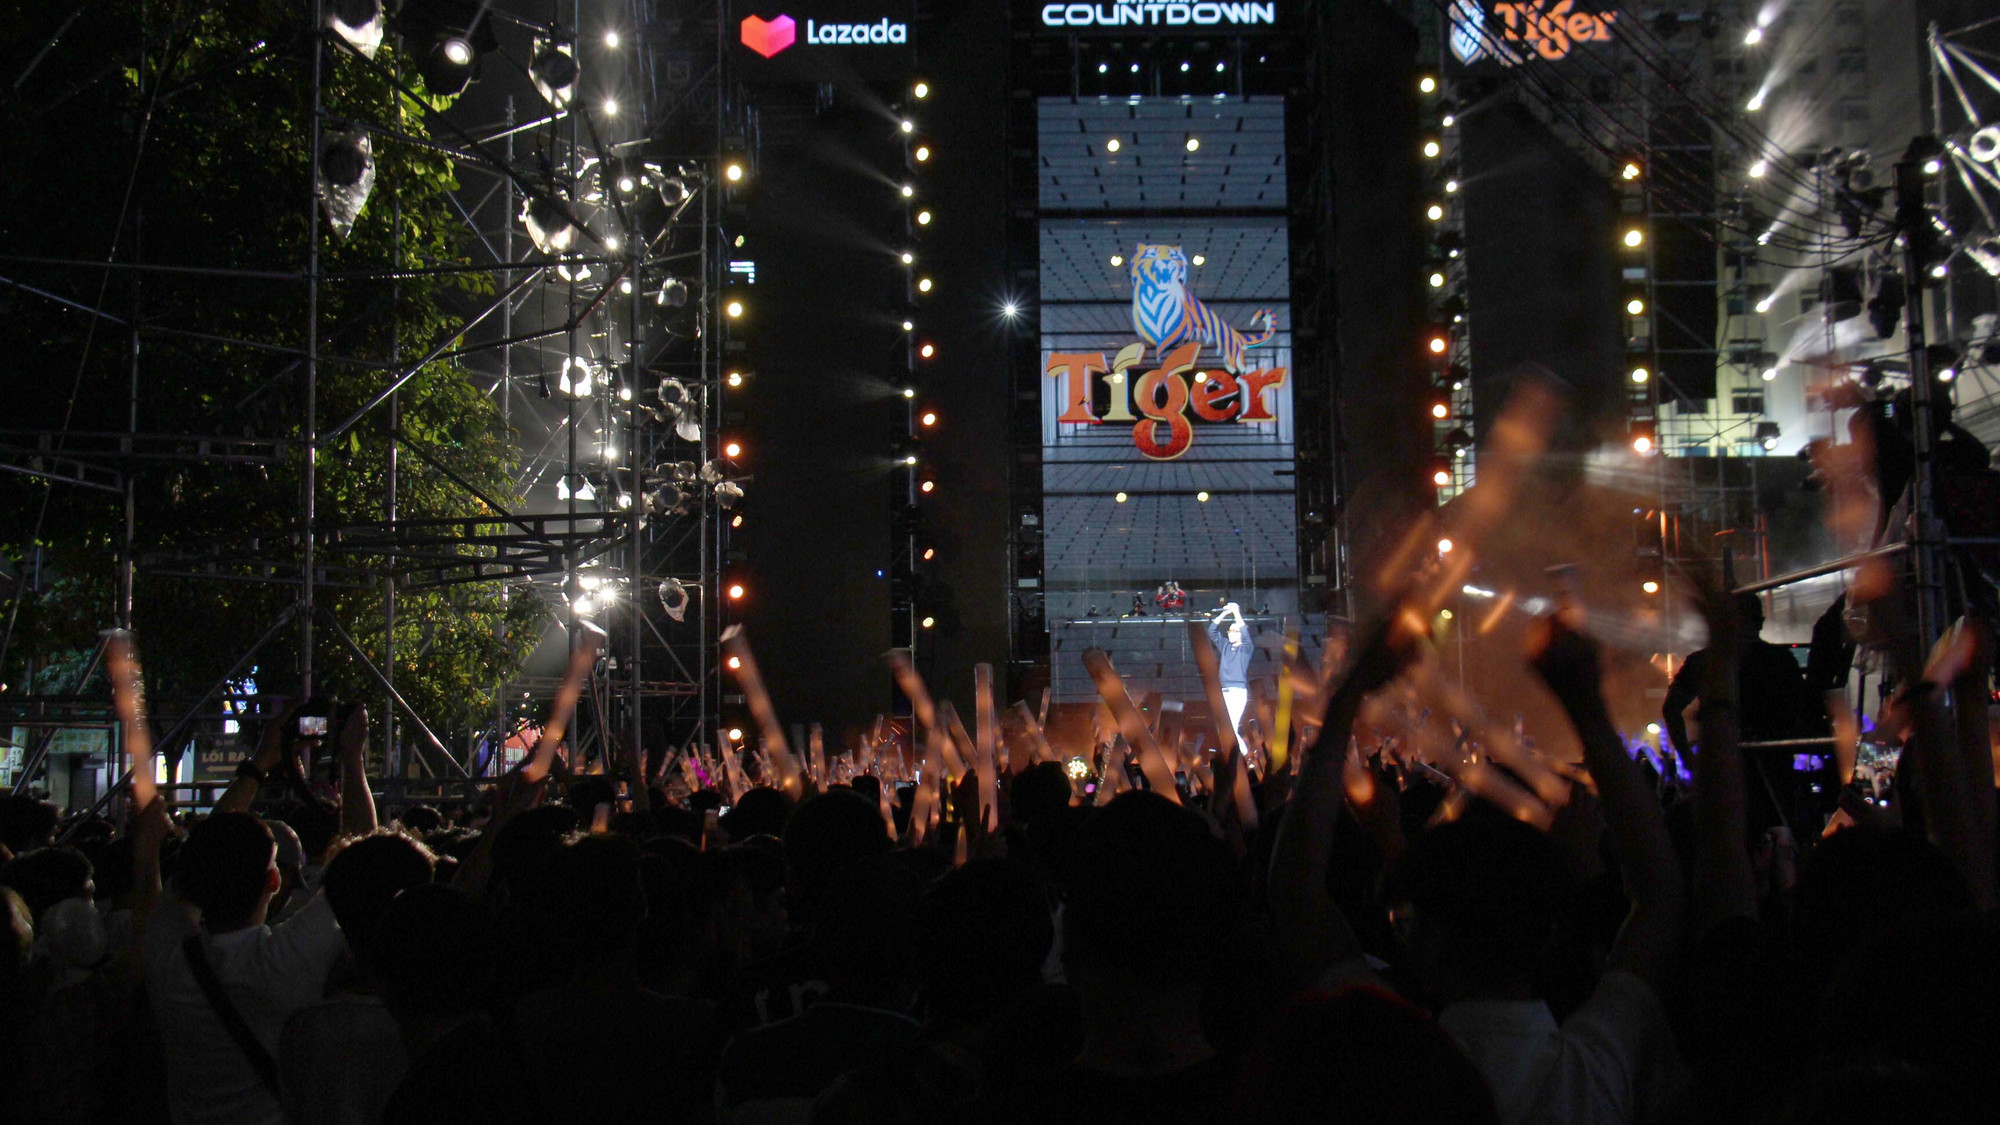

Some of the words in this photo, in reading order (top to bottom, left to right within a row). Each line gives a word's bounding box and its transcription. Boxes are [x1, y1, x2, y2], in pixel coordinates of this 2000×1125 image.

[807, 17, 906, 44] Lazada
[1042, 2, 1275, 25] COUNTDOWN
[1493, 0, 1618, 60] Tiger
[1046, 342, 1287, 460] Tiger
